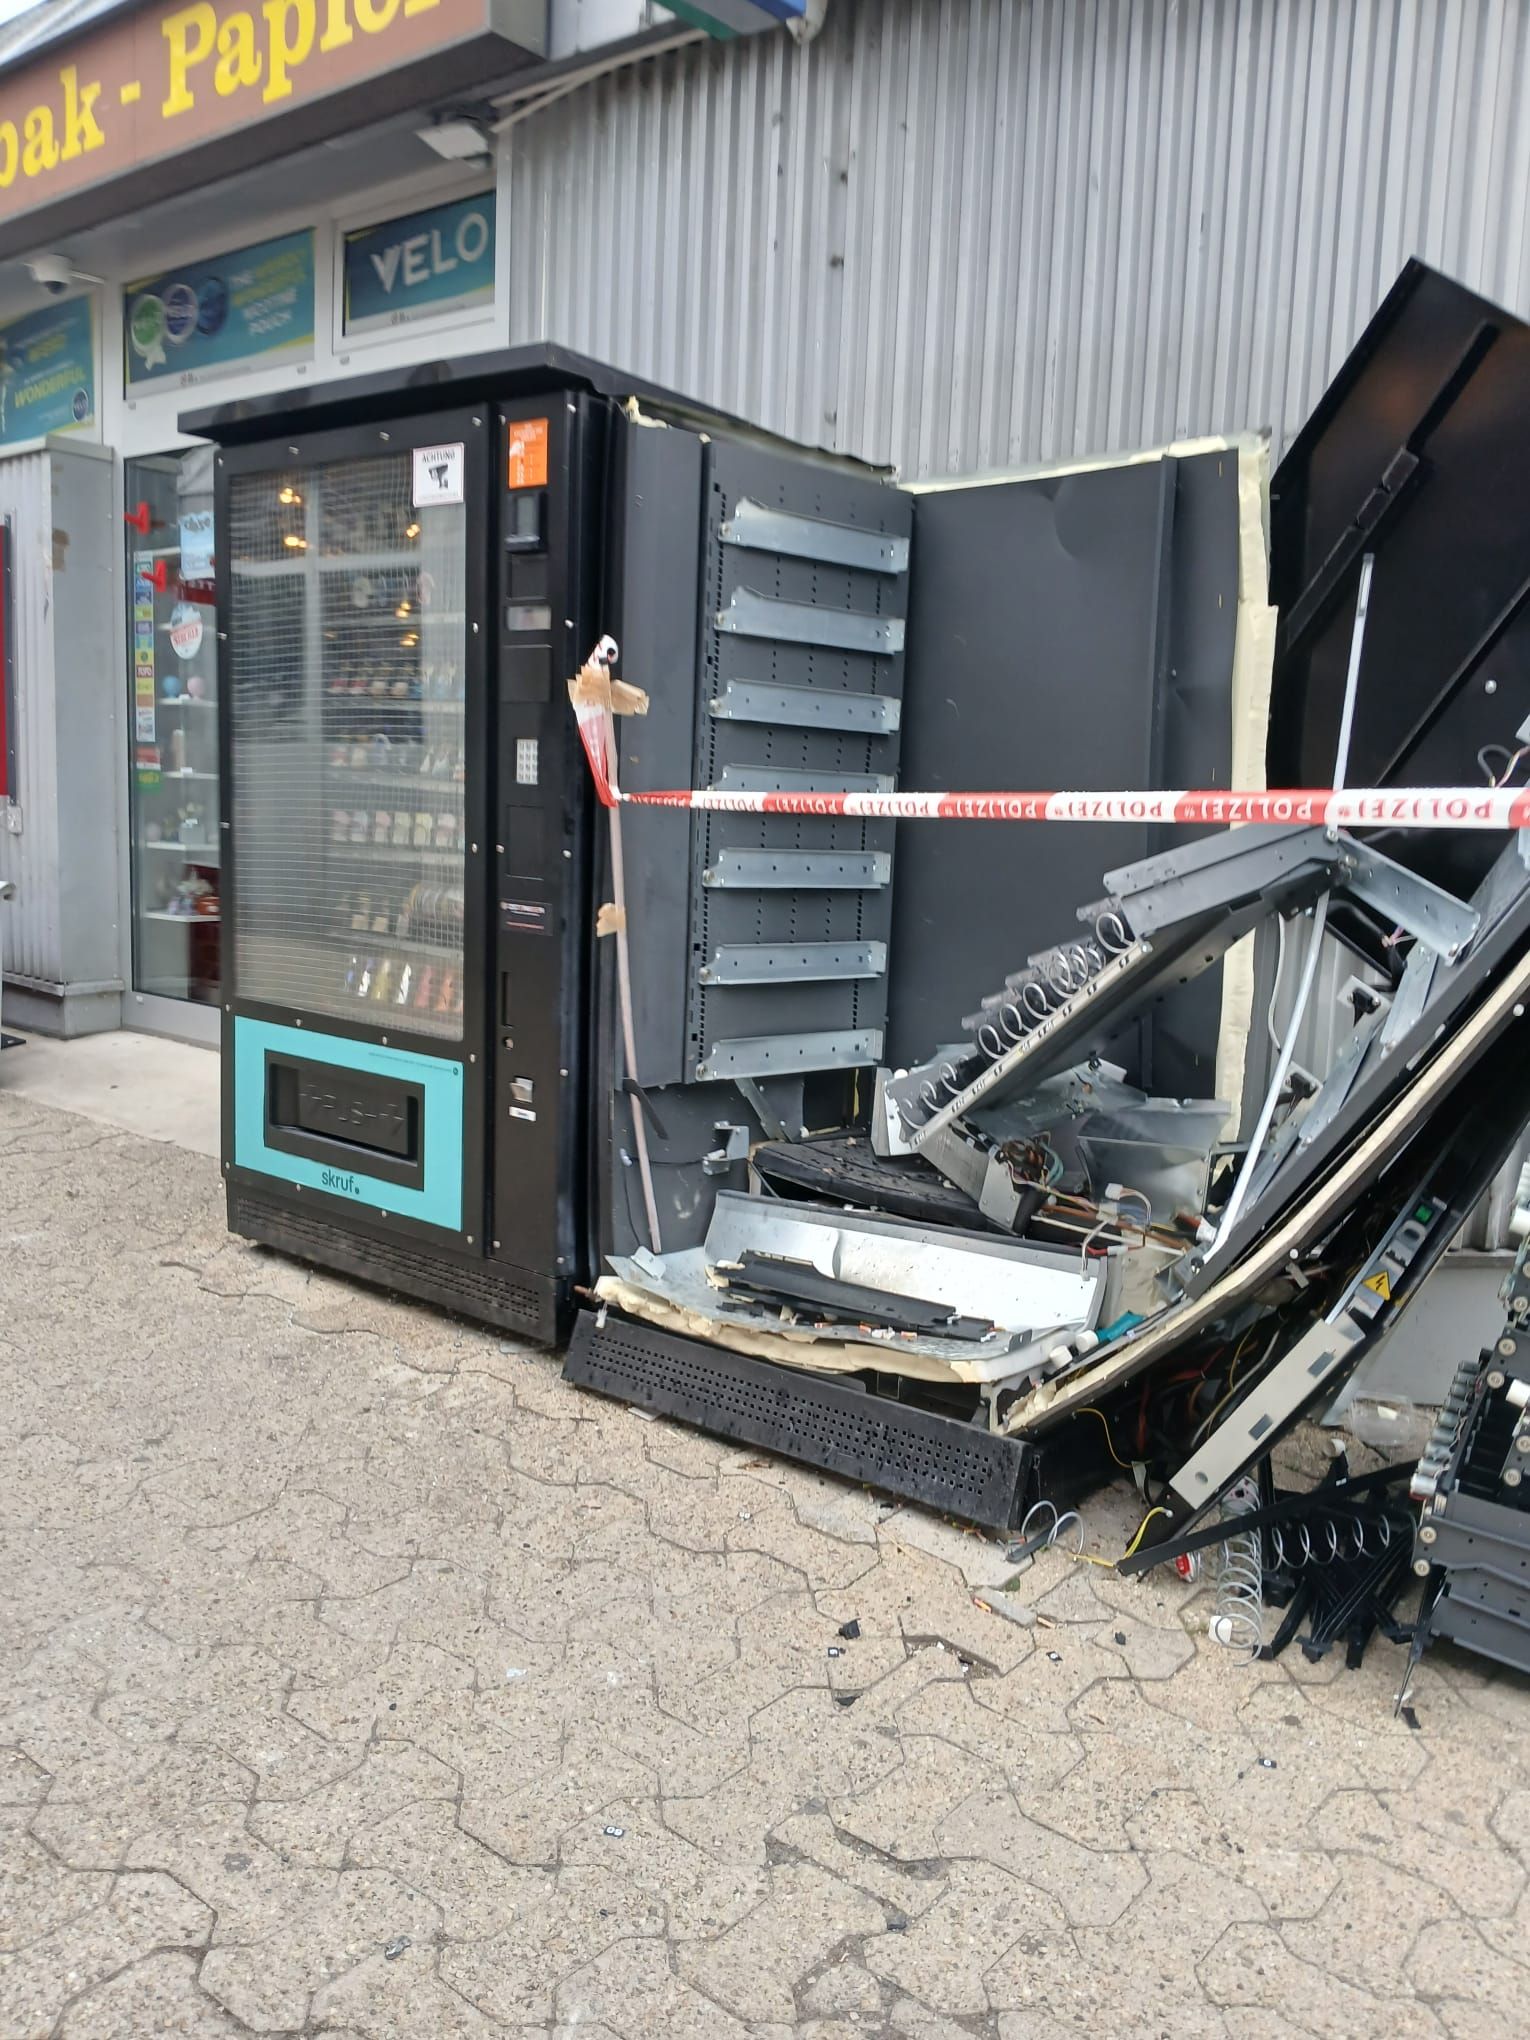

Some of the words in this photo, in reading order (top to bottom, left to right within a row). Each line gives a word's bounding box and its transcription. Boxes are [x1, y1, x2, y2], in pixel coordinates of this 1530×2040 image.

[370, 212, 489, 294] VELO
[14, 366, 86, 409] WONDERFUL
[422, 449, 456, 463] ACHTUNG
[776, 798, 837, 814] POLIZEI
[860, 800, 930, 816] POLIZEI
[957, 800, 1036, 818] POLIZEI
[1070, 800, 1163, 818] POLIZEI
[1202, 798, 1312, 819] POLIZEI
[1359, 798, 1495, 820] POLIZEI
